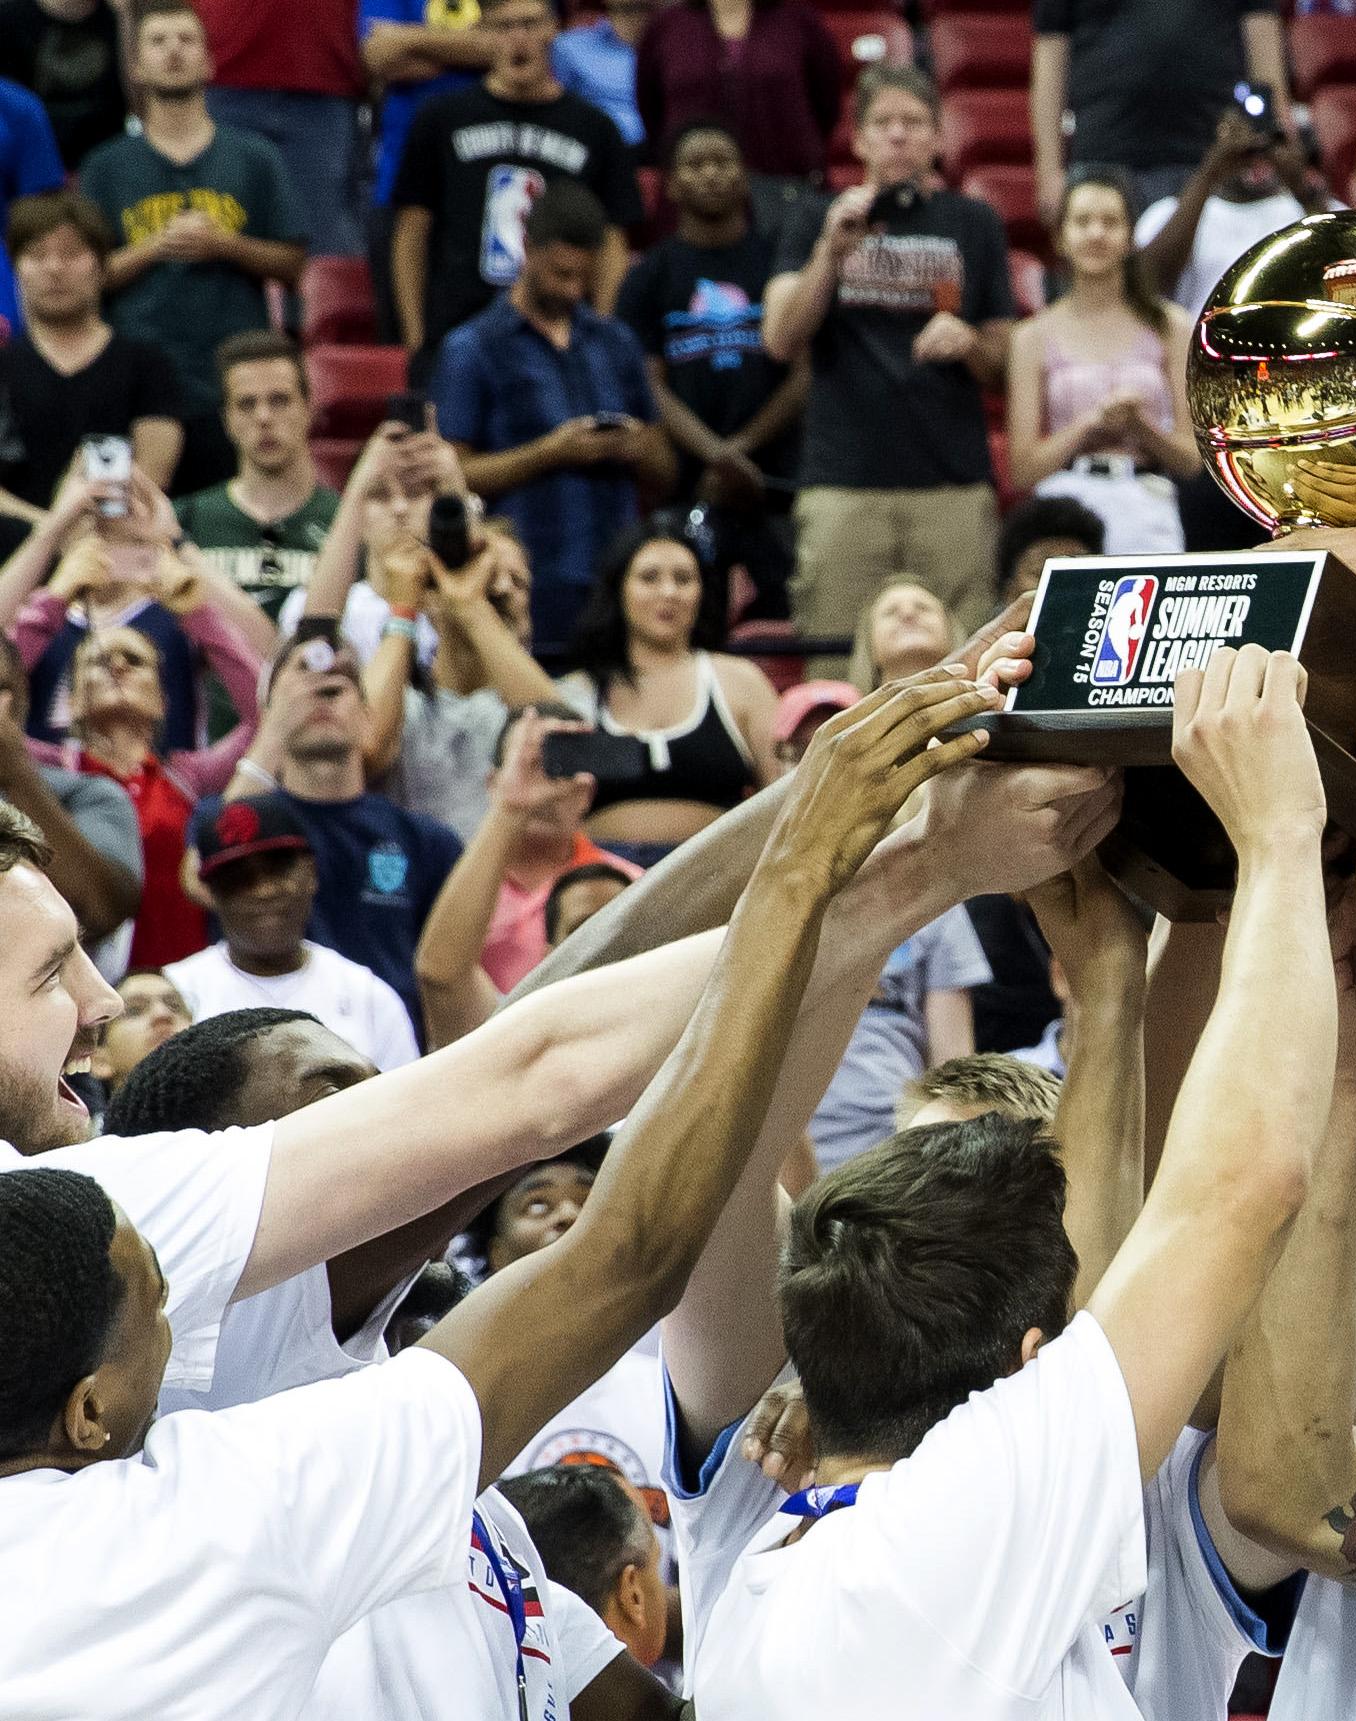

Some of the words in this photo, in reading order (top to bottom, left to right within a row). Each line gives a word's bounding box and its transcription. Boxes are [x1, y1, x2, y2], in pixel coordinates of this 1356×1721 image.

[1164, 576, 1197, 592] MGM
[1198, 574, 1258, 591] RESORTS
[1080, 579, 1114, 658] SEASON
[1152, 595, 1251, 640] SUMMER
[1072, 663, 1091, 684] 15
[1139, 639, 1225, 683] LEAGU
